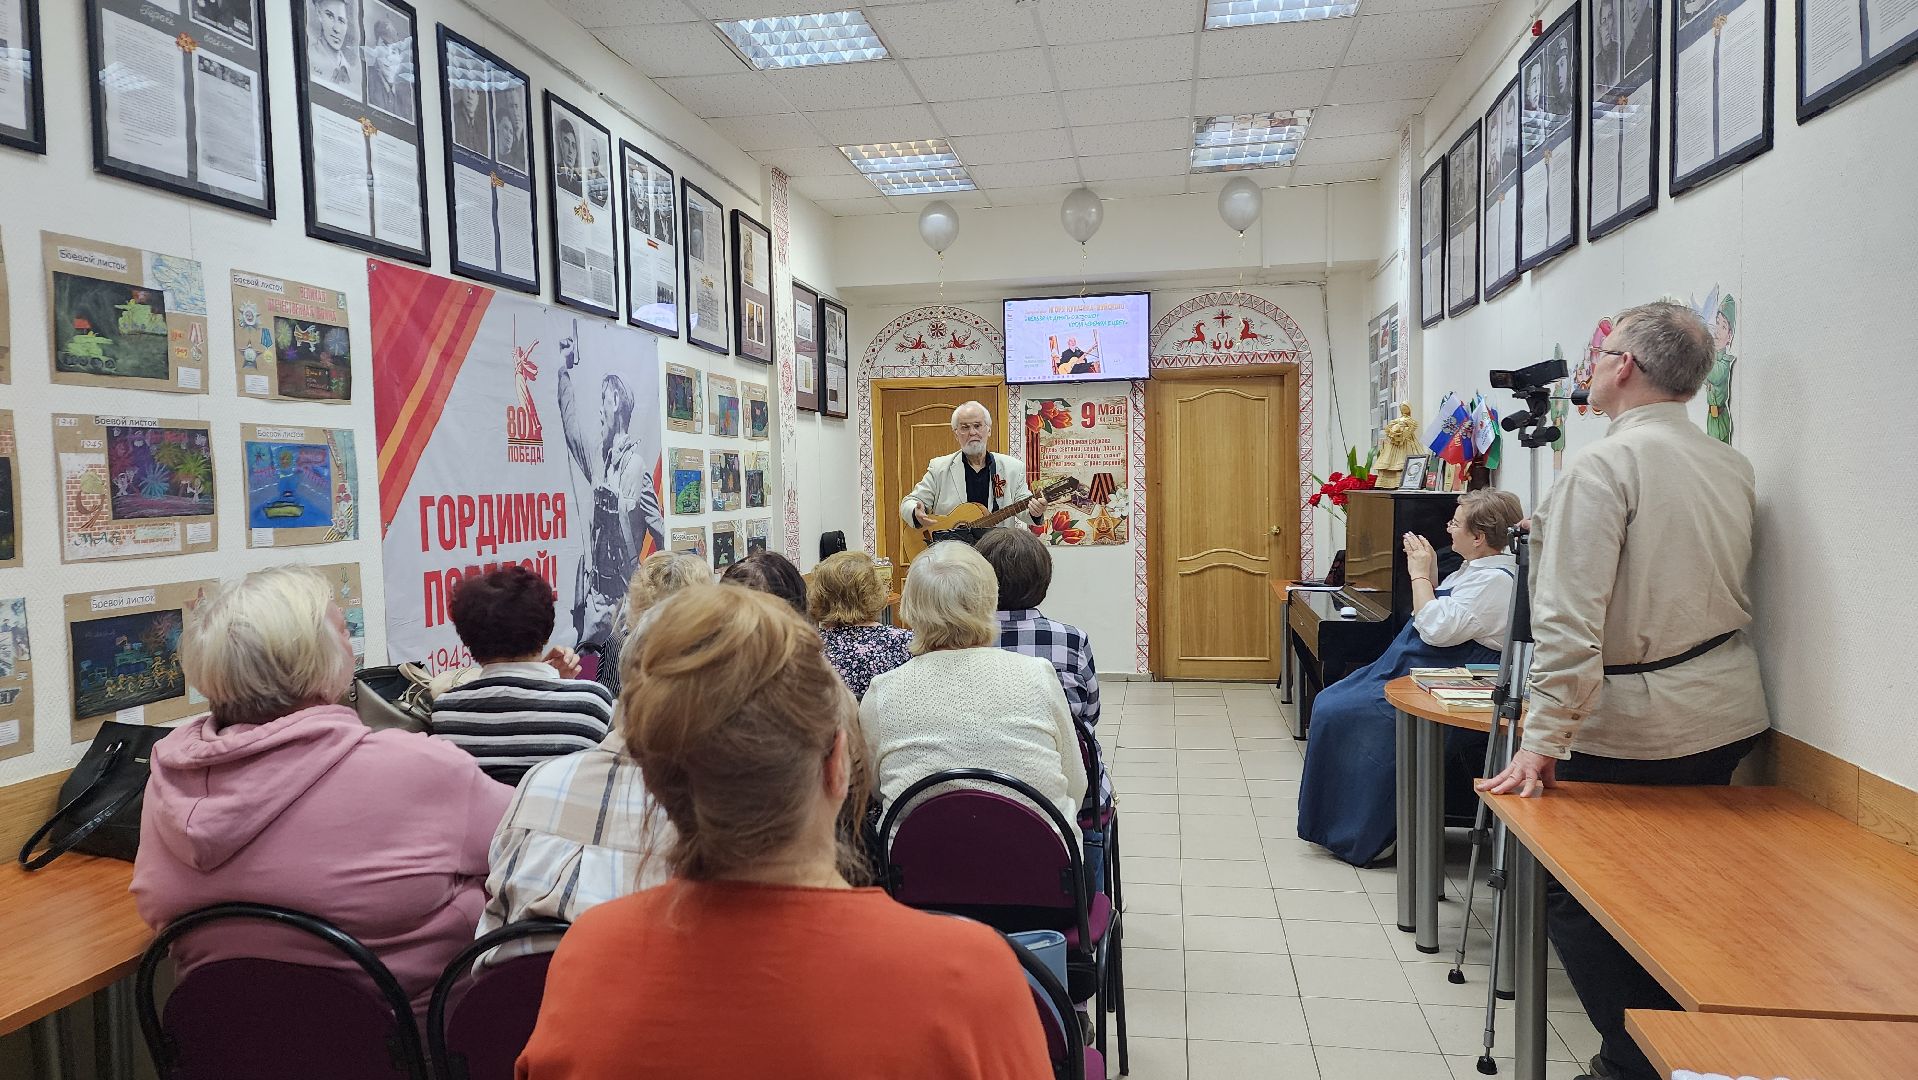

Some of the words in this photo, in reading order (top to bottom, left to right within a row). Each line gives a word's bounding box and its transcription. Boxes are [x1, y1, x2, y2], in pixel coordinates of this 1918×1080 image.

[59, 249, 96, 265] Боевой
[96, 257, 127, 270] листок
[233, 275, 259, 287] Боевой
[260, 280, 283, 292] листок
[94, 415, 127, 426] Боевой
[128, 418, 157, 427] листок
[507, 405, 527, 439] 80
[1081, 402, 1096, 428] 9
[1098, 403, 1123, 416] Мая
[508, 446, 545, 465] ПОБЕДА!
[419, 492, 567, 556] ГОРДИМСЯ
[92, 597, 124, 609] Боевой
[125, 595, 155, 605] листок
